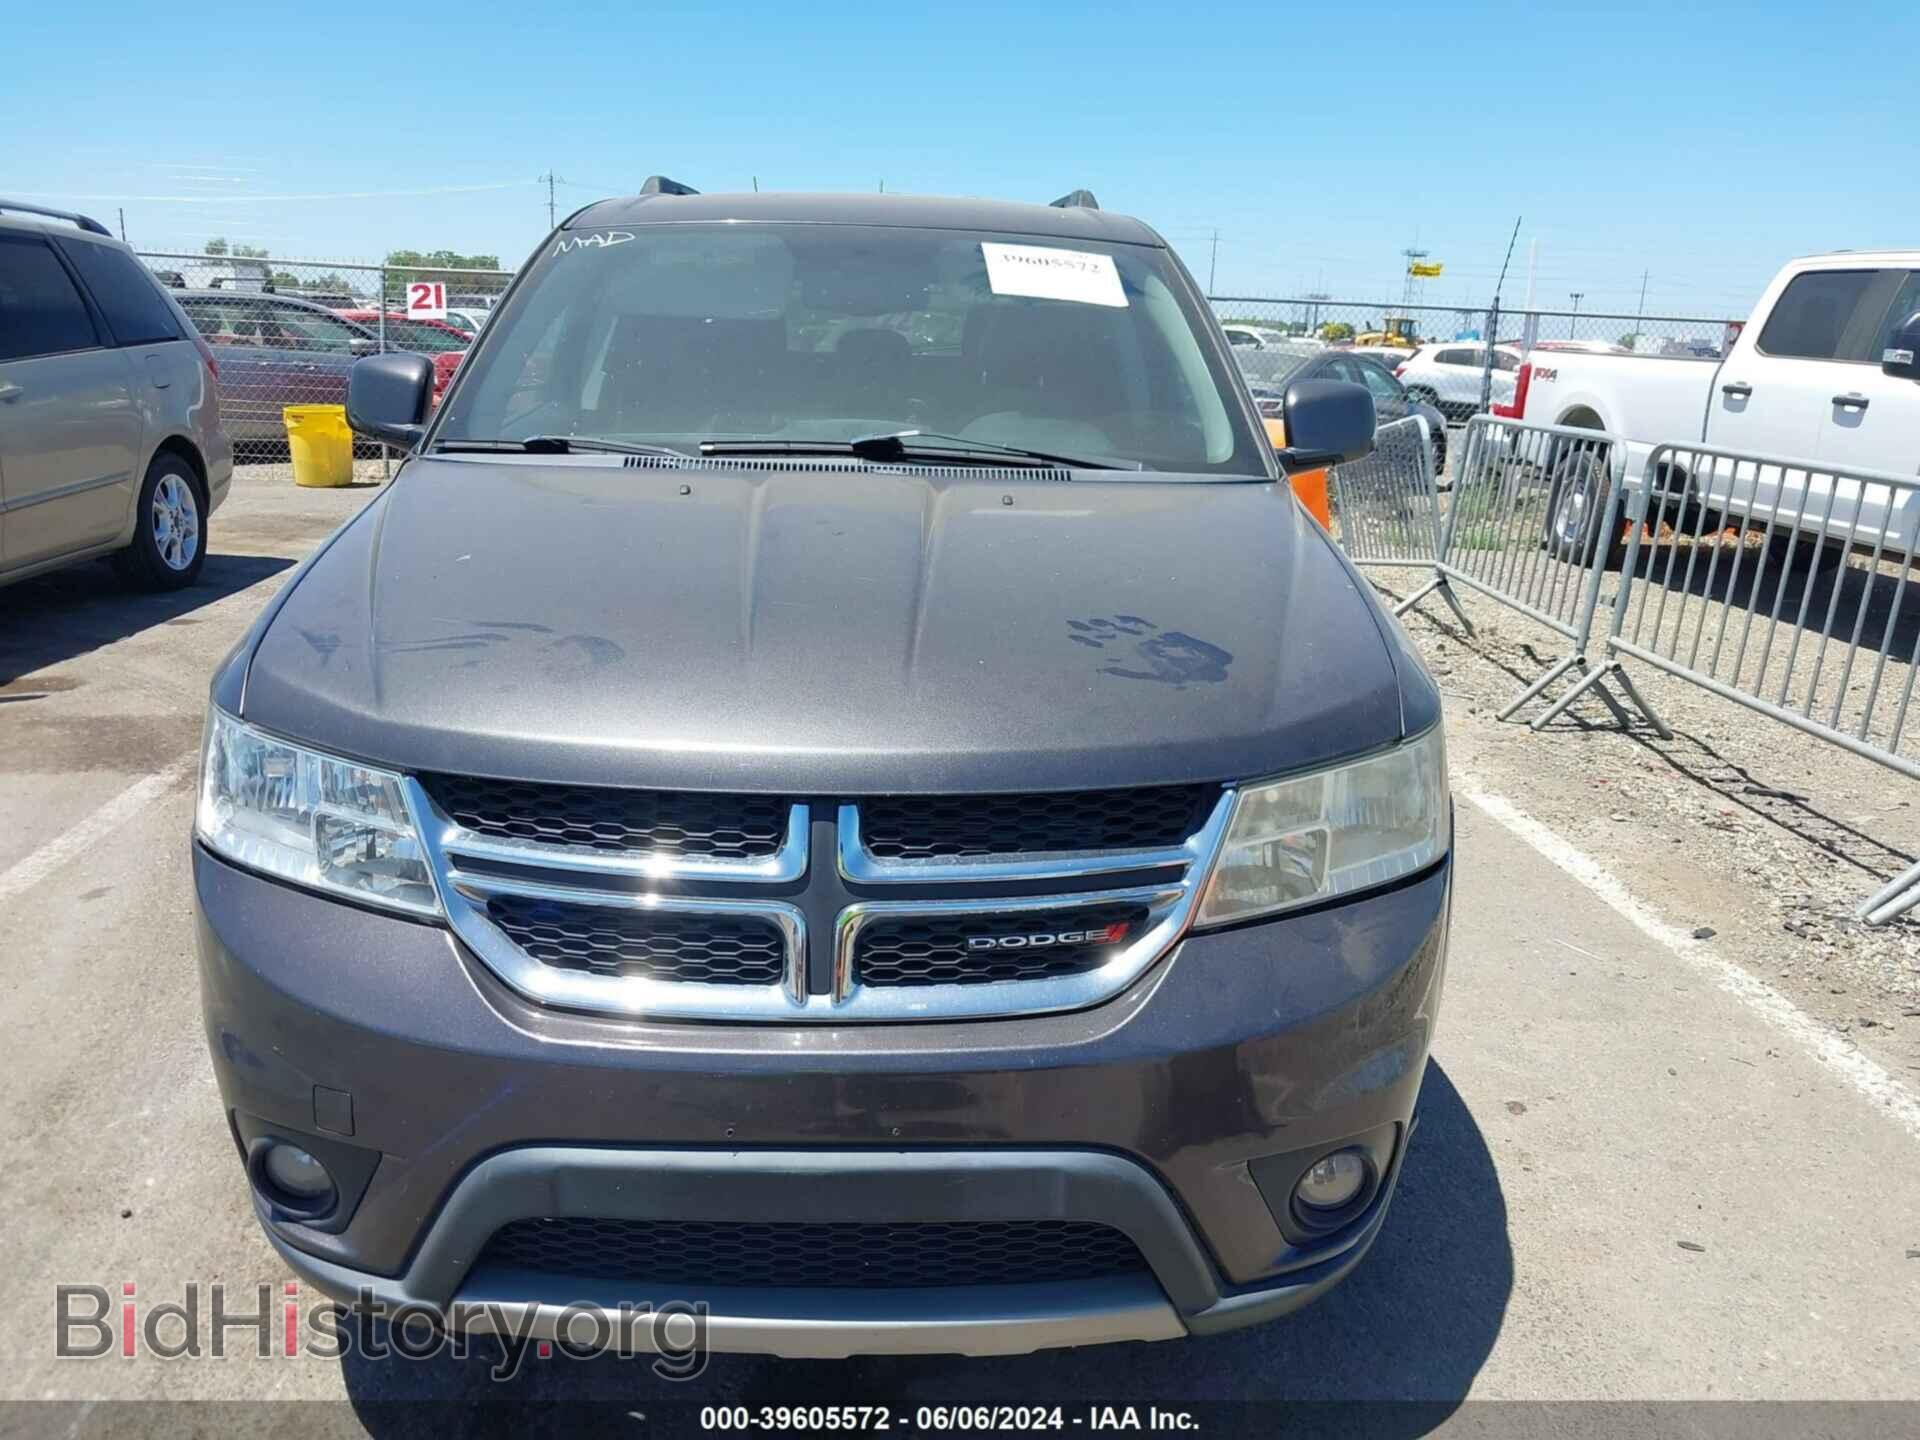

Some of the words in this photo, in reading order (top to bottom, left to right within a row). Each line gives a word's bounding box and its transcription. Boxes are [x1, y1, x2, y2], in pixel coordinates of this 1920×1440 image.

[552, 232, 636, 257] MAD
[411, 284, 443, 309] 21
[968, 928, 1110, 949] DODGE
